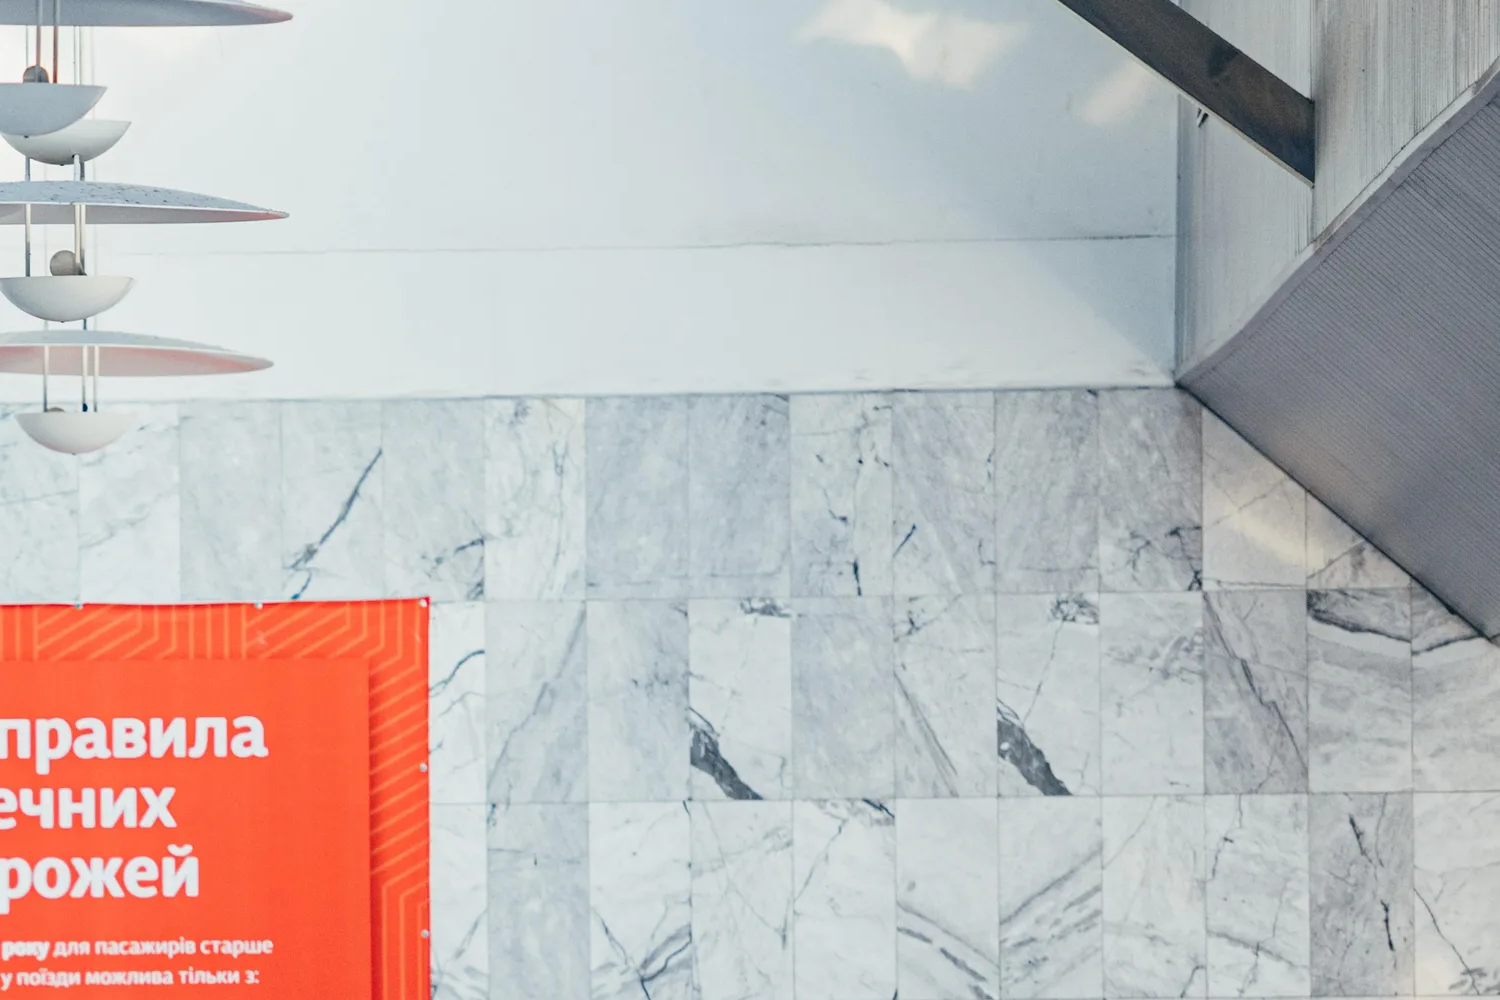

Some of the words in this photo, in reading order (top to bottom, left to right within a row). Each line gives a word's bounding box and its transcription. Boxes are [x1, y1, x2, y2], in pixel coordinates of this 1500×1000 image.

[3, 942, 49, 960] року
[52, 941, 88, 956] для
[95, 937, 195, 959] пасажирів
[200, 939, 273, 958] старше
[0, 972, 12, 990] у
[17, 970, 79, 988] поїзди
[85, 971, 172, 987] можлива
[179, 969, 239, 985] тільки
[245, 970, 259, 985] з:
